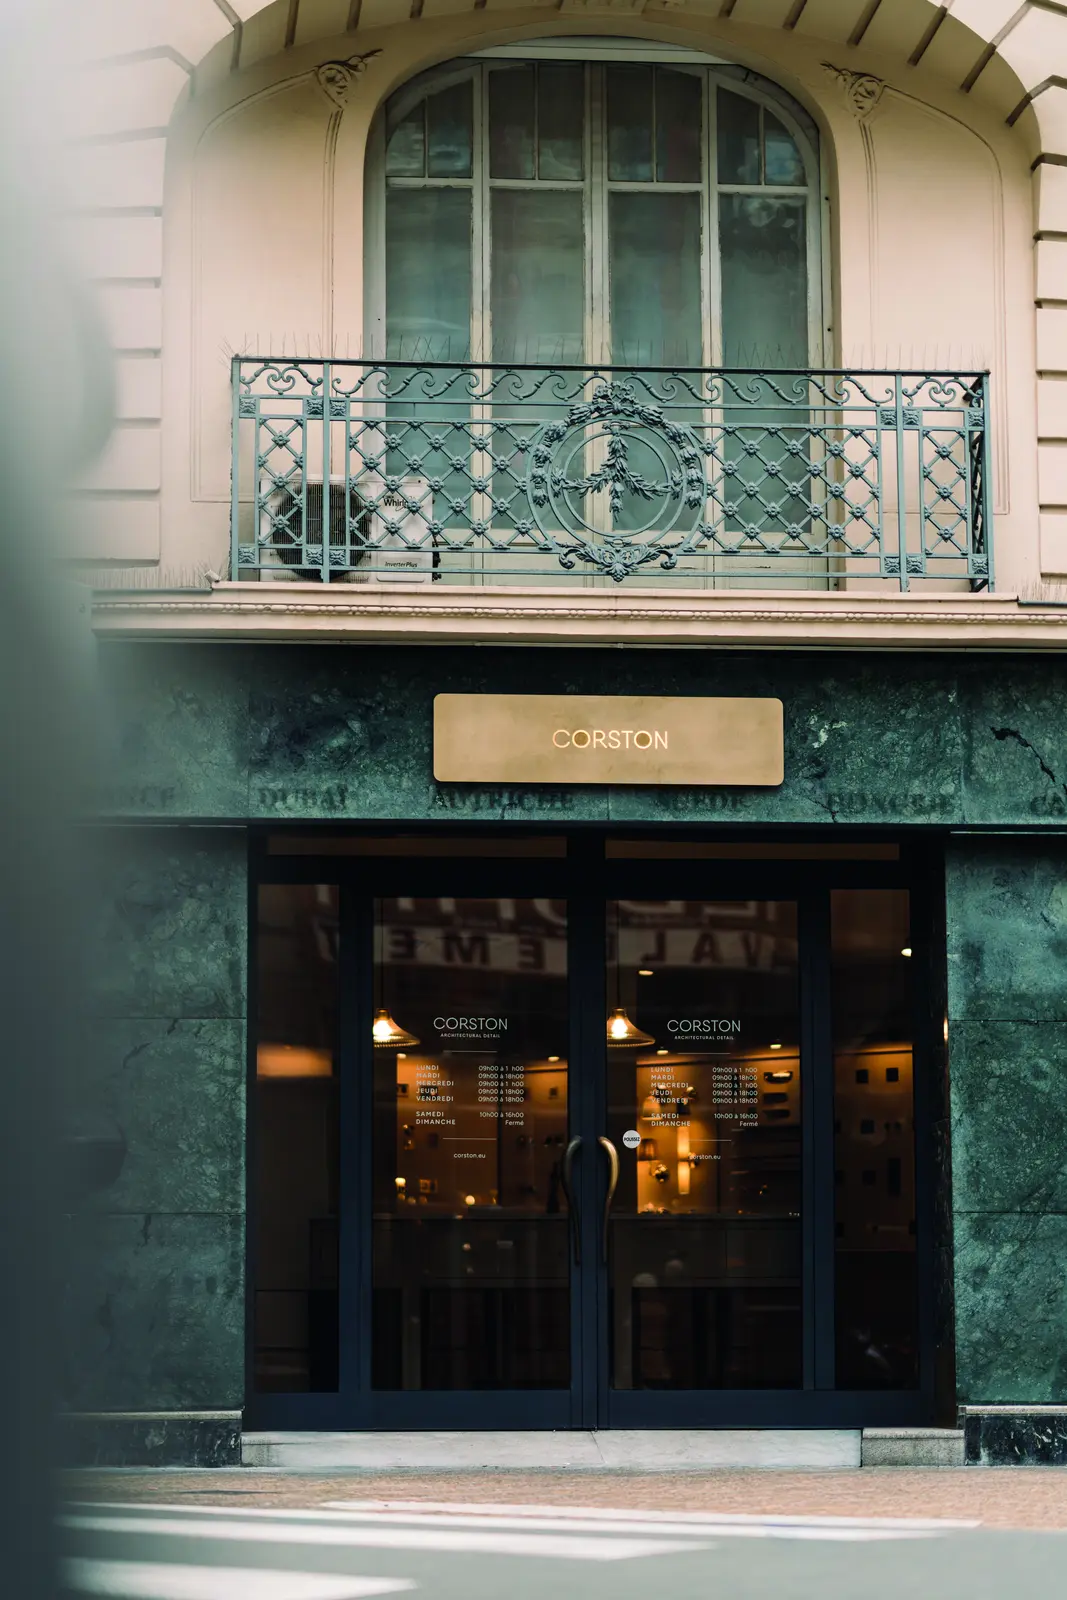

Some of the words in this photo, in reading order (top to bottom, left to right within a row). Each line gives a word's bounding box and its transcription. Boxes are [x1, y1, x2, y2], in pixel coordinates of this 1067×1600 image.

[552, 729, 668, 750] CORSTON
[433, 1017, 508, 1030] CORSTON
[667, 1019, 741, 1032] CORSTON
